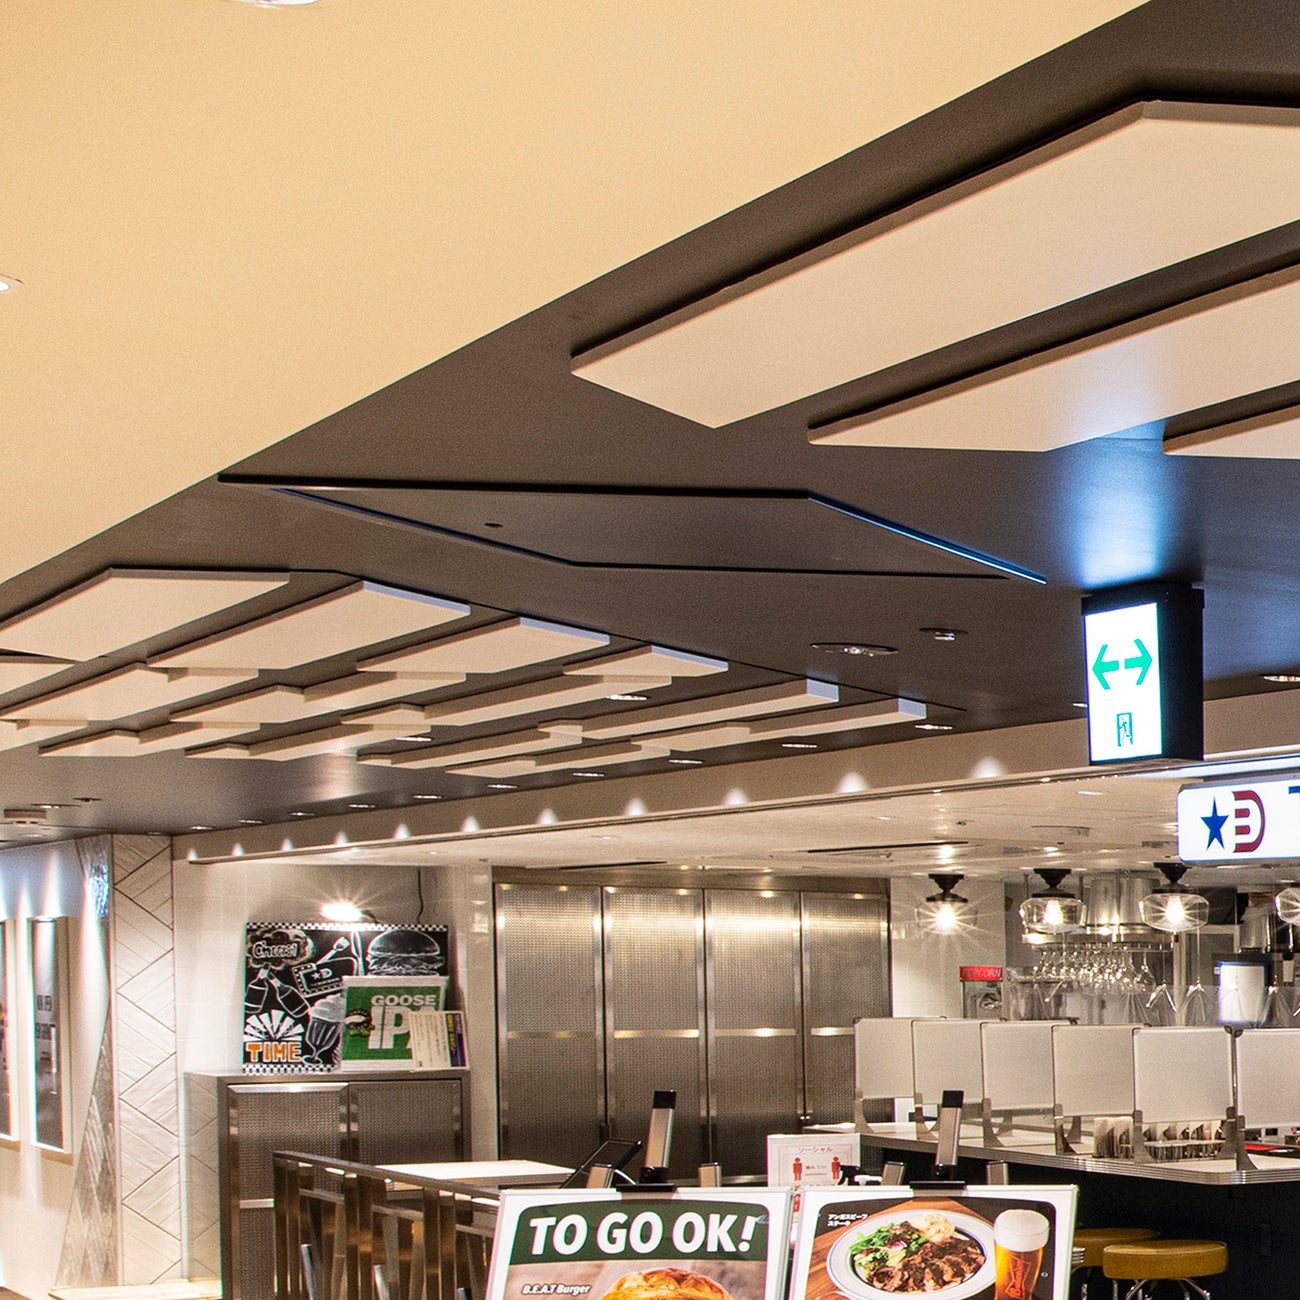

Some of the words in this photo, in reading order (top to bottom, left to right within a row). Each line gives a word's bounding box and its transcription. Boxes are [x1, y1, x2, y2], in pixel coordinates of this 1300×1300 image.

[370, 994, 437, 1007] GOOSE
[367, 1005, 413, 1050] IP
[245, 1041, 302, 1063] TIME
[529, 1214, 588, 1255] TO
[596, 1211, 664, 1254] GO
[672, 1211, 758, 1254] OK!
[556, 1284, 591, 1297] Burger
